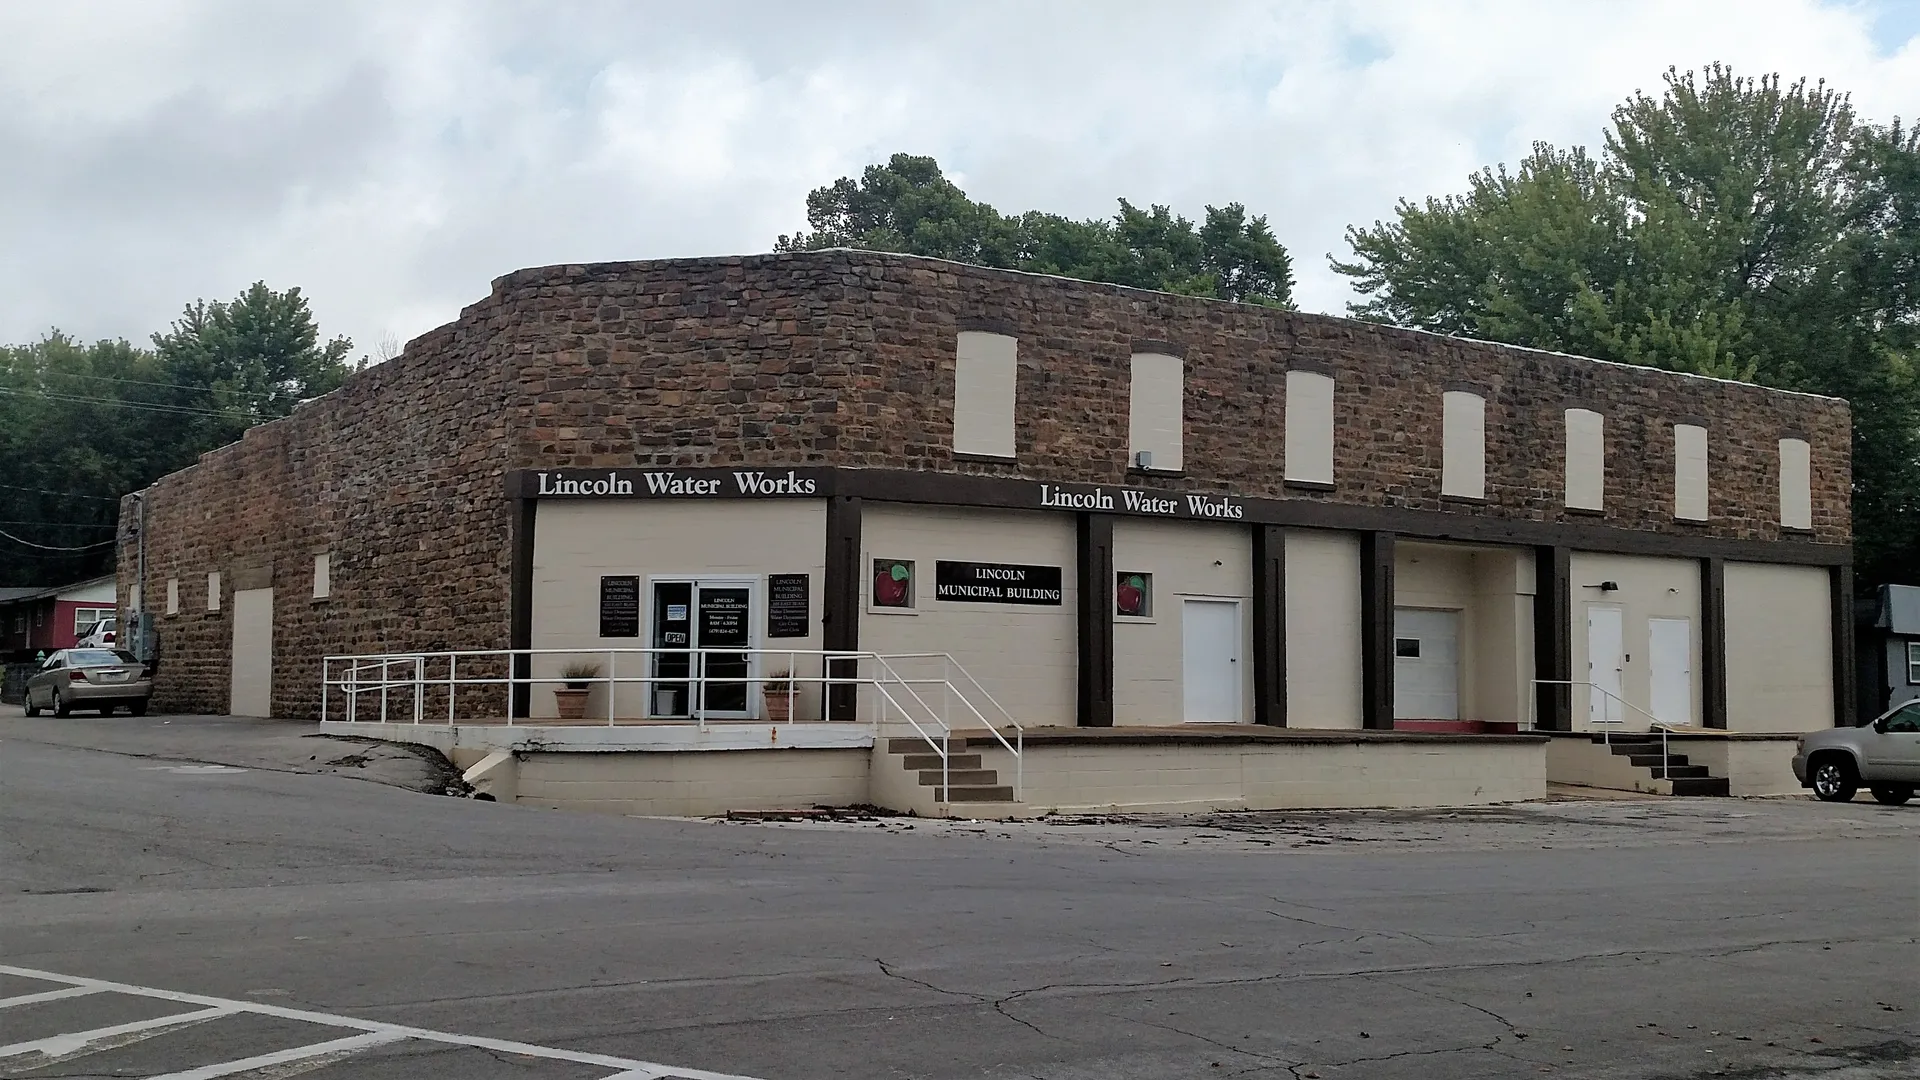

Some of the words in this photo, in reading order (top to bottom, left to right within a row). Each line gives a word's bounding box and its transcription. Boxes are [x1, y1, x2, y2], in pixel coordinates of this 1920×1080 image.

[538, 472, 633, 495] Lincoln
[643, 472, 721, 495] Water
[733, 470, 816, 495] Works
[1040, 484, 1114, 509] Lincoln
[1122, 490, 1178, 514] Water
[1186, 495, 1243, 519] Works
[976, 568, 1025, 580] LINCOLN
[938, 584, 1003, 597] MUNICIPAL
[1007, 588, 1060, 600] BUILDING
[667, 633, 685, 643] OPEN
